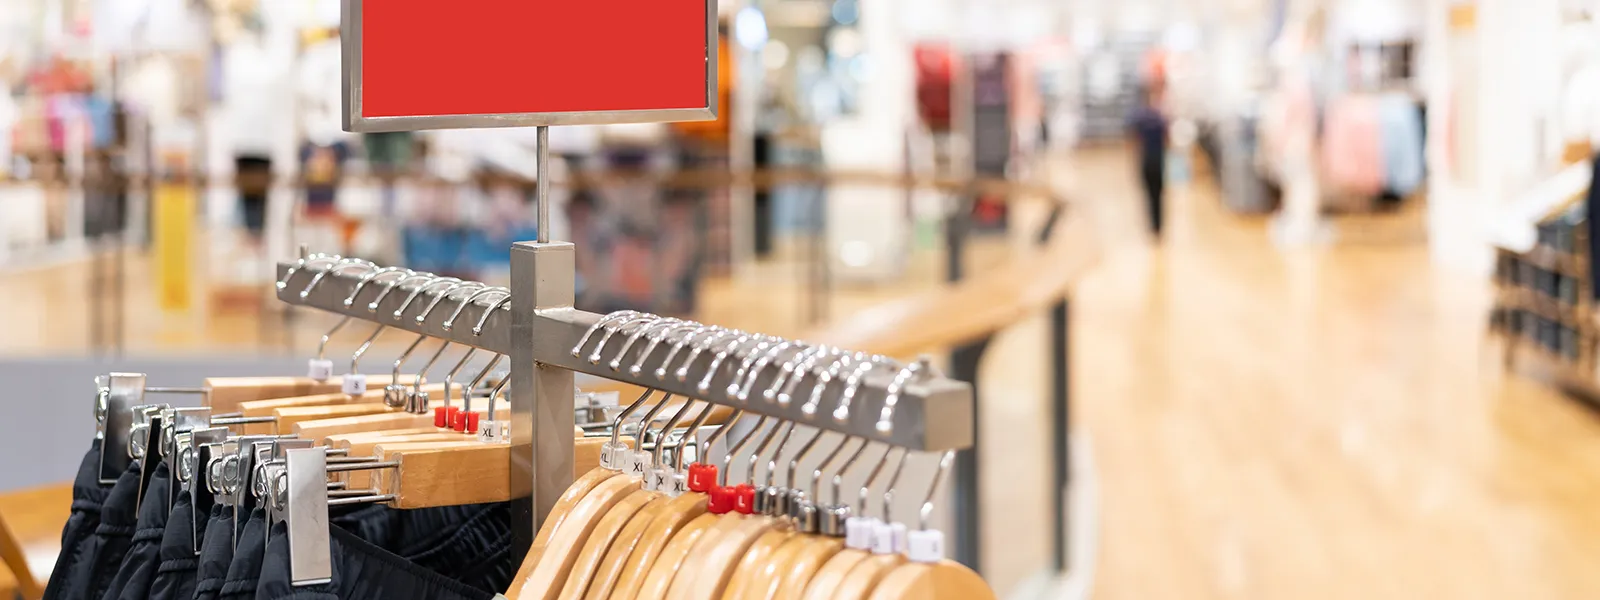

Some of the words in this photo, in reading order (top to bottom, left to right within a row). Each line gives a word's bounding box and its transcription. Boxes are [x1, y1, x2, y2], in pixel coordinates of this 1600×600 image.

[482, 427, 494, 438] XL
[694, 474, 700, 485] L
[674, 481, 686, 491] XL
[738, 495, 745, 507] L
